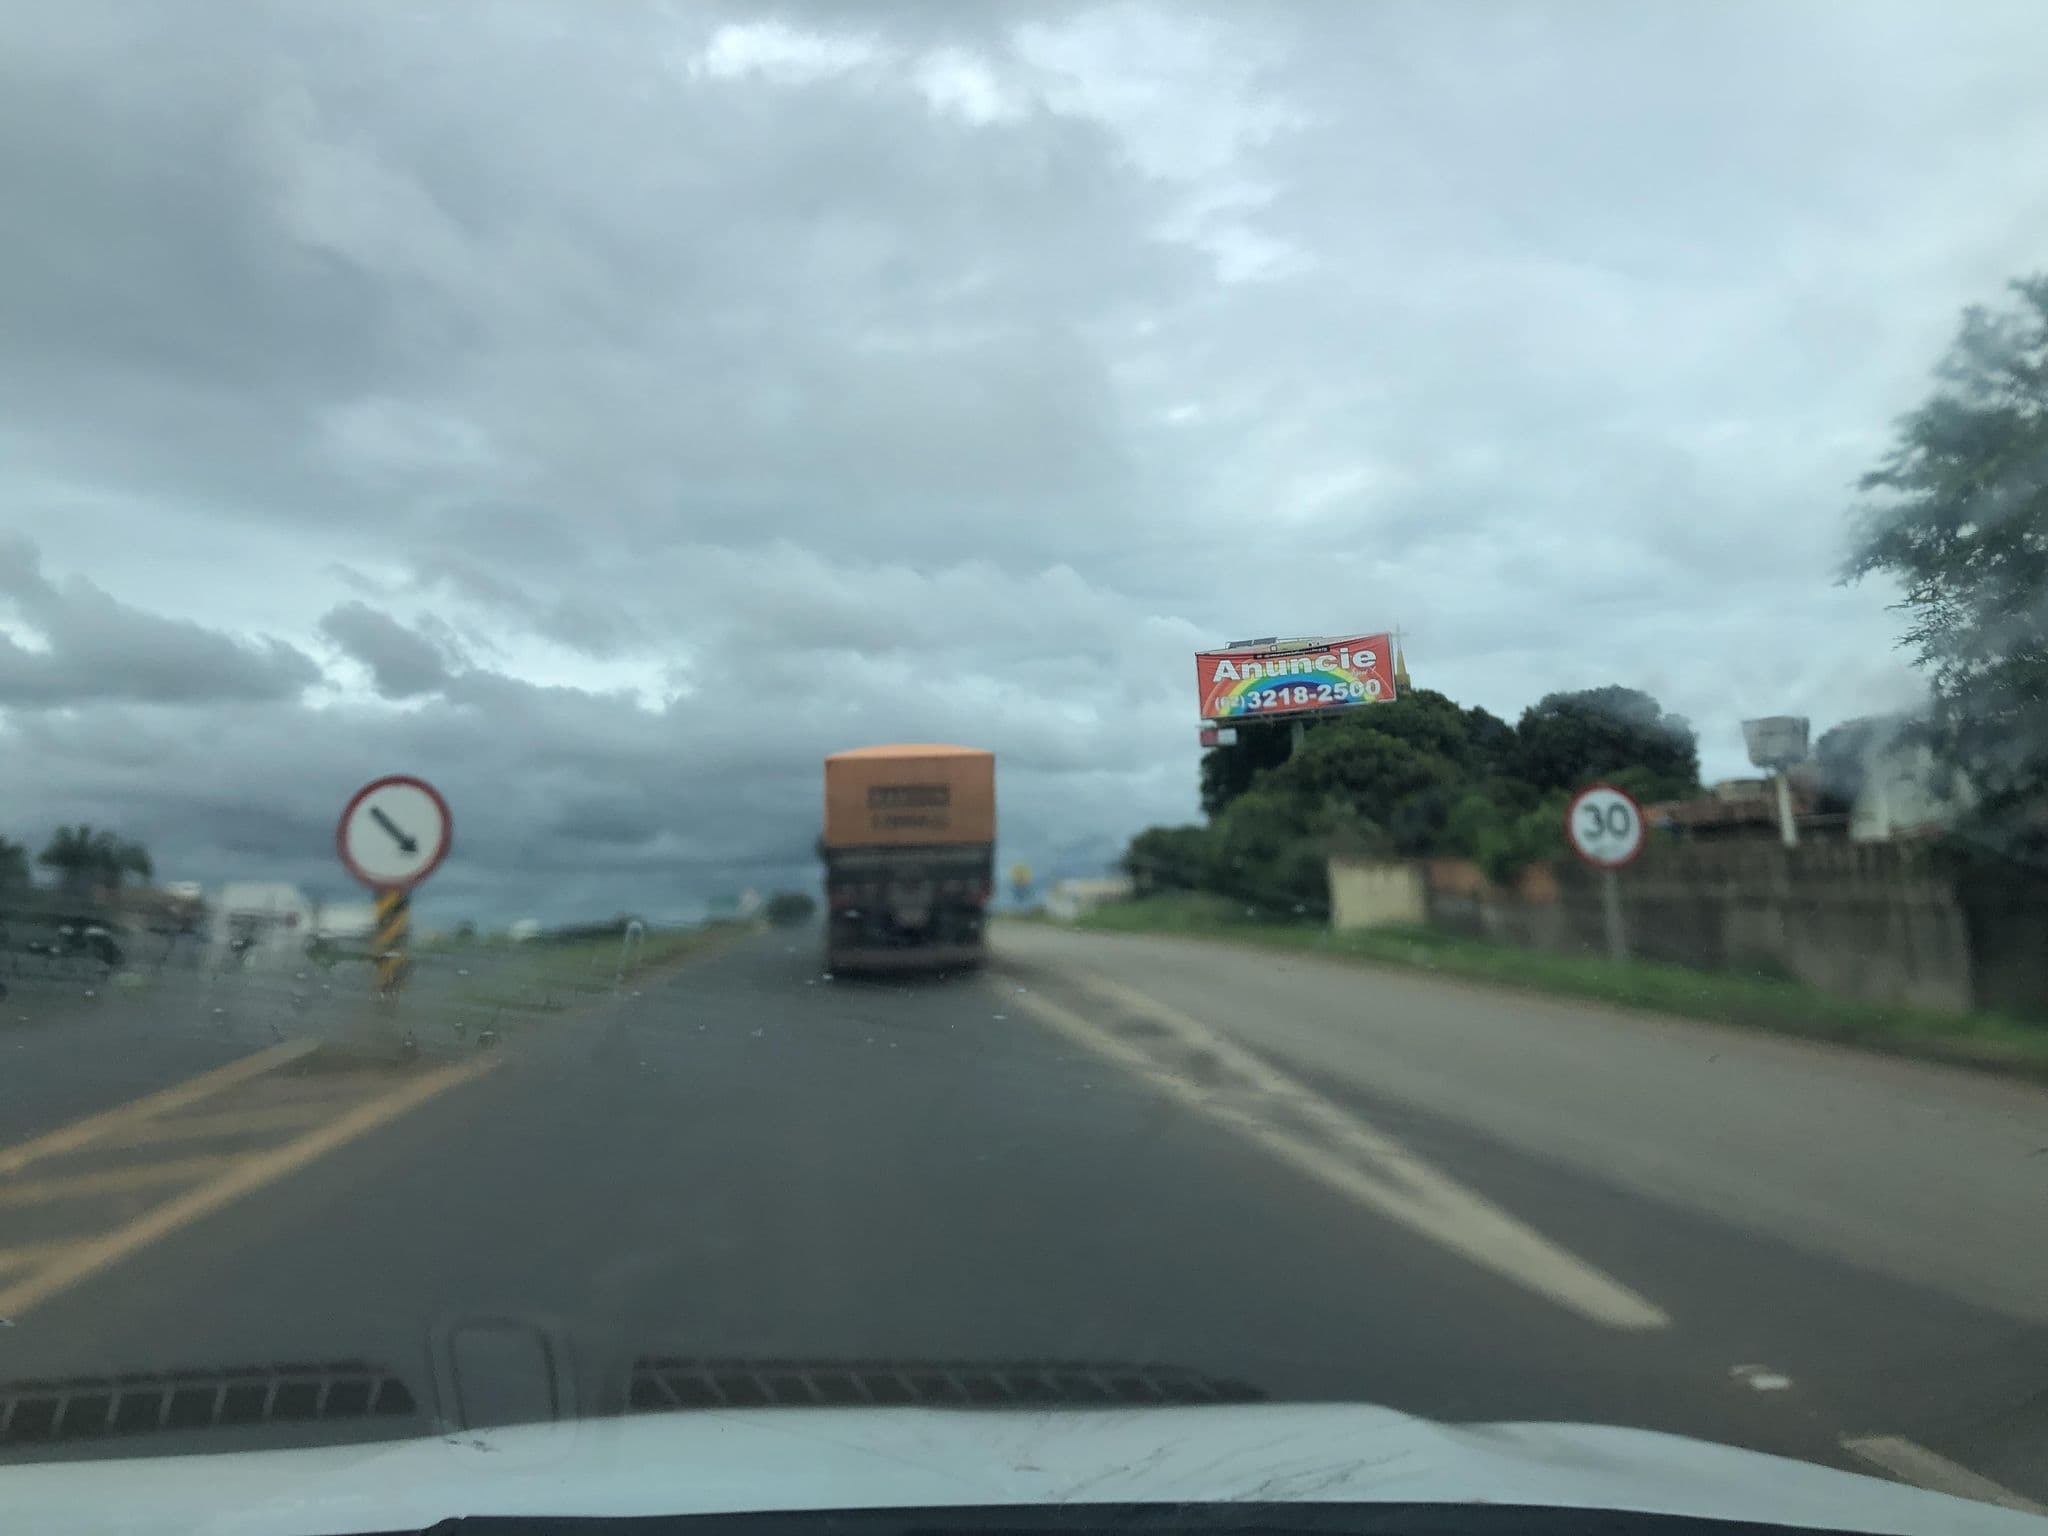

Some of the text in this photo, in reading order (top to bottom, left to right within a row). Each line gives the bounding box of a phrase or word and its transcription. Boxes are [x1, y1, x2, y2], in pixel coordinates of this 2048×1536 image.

[1213, 647, 1377, 683] Anuncie
[1247, 679, 1381, 709] 3218-2500
[1583, 803, 1631, 839] 30
